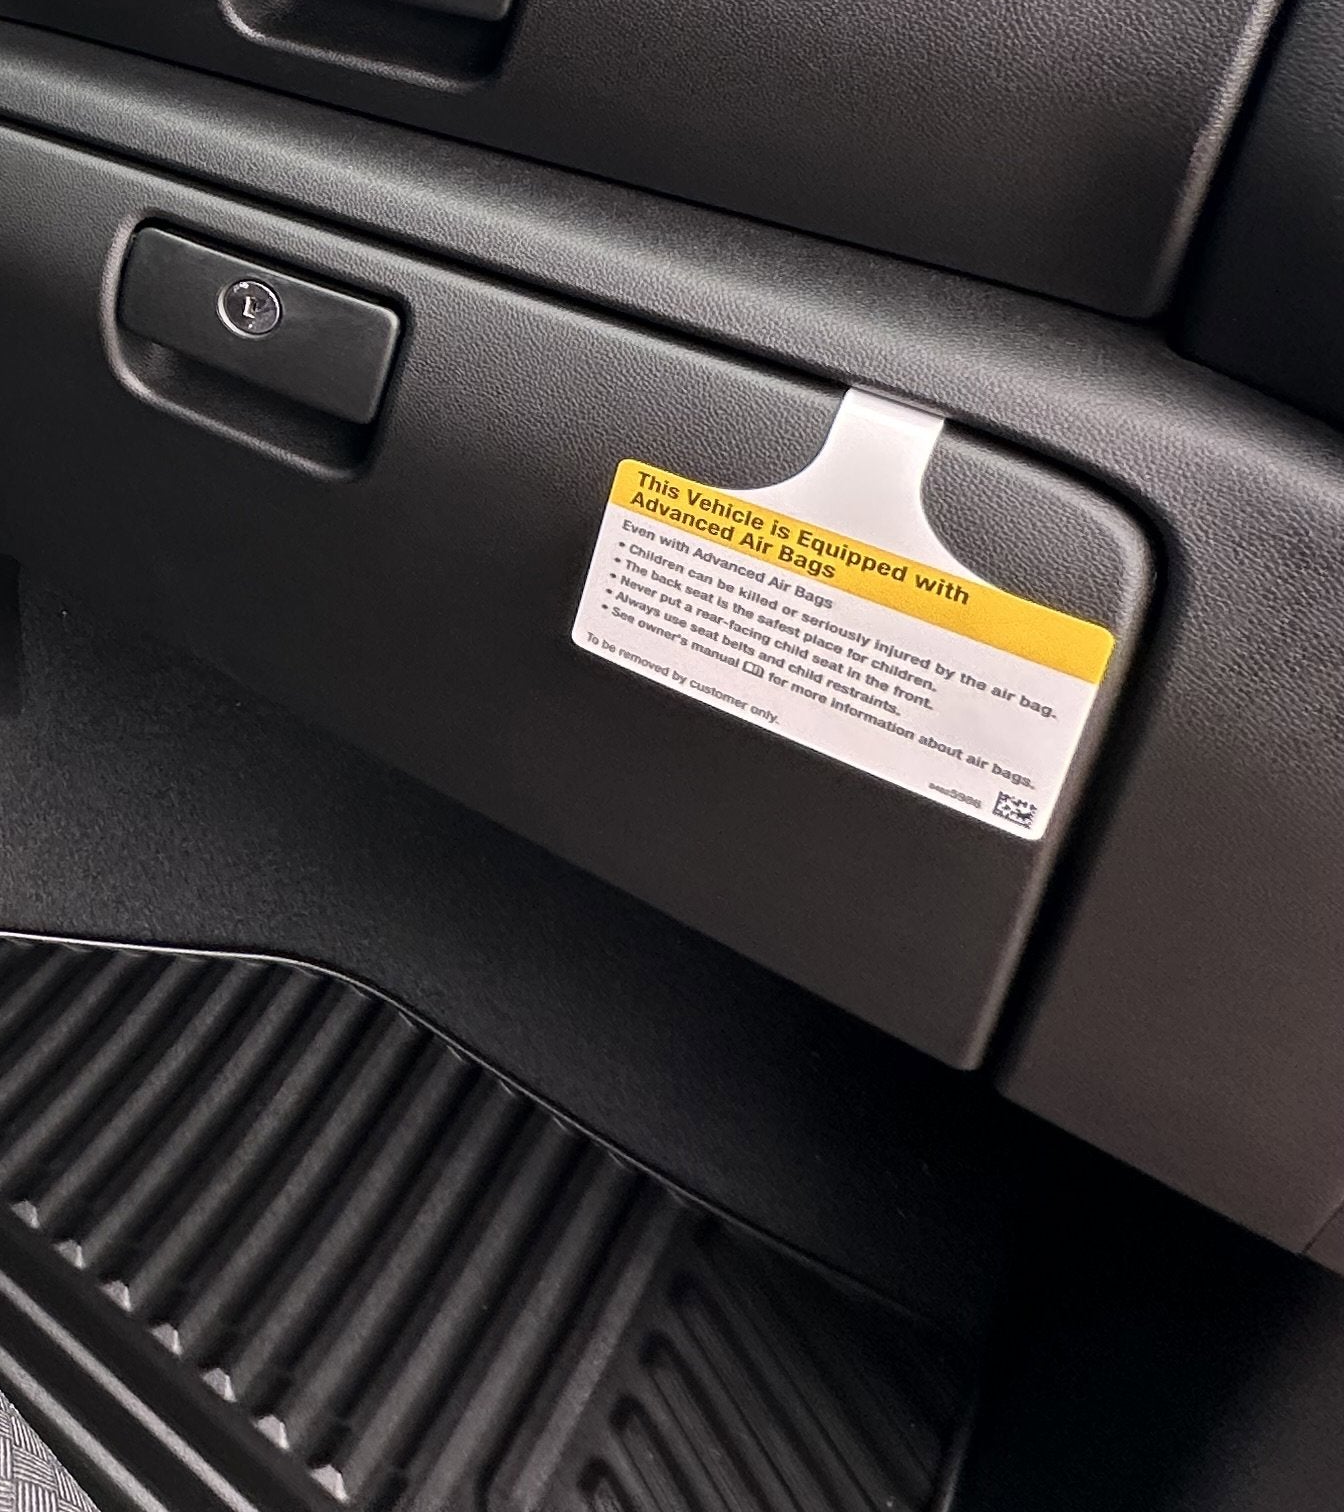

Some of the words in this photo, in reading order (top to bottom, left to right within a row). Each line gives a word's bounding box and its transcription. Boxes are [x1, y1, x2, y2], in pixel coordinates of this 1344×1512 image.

[620, 518, 657, 542] Even
[658, 534, 691, 555] with
[691, 546, 767, 585] Advanced
[766, 575, 793, 593] Air
[793, 584, 834, 610] Bags
[628, 489, 737, 546] Advanced
[737, 531, 775, 556] Air
[776, 543, 837, 580] Bags
[636, 470, 681, 501] This
[686, 487, 766, 532] Vehicle
[769, 518, 793, 541] is
[795, 528, 910, 584] Equipped
[914, 573, 971, 607] with
[586, 630, 601, 646] To
[600, 638, 617, 654] be
[617, 647, 671, 678] removed
[671, 669, 689, 686] by
[688, 679, 750, 711] customer
[749, 704, 780, 726] only.
[614, 590, 662, 618] Always
[662, 611, 688, 629] use
[688, 622, 721, 643] seat
[720, 633, 756, 657] belts
[757, 650, 787, 670] and
[787, 663, 825, 685] child
[825, 678, 902, 718] restraints.
[619, 574, 659, 599] Never
[658, 592, 683, 610] put
[682, 602, 694, 614] a
[694, 607, 773, 647] rear-facing
[773, 639, 811, 661] child
[810, 654, 845, 675] seat
[845, 665, 862, 682] in
[864, 673, 891, 693] the
[892, 684, 935, 711] front.
[625, 558, 649, 578] The
[650, 569, 683, 592] back
[683, 585, 715, 605] seat
[715, 595, 730, 611] is
[731, 601, 756, 620] the
[756, 614, 802, 639] safest
[801, 631, 844, 656] place
[845, 647, 870, 665] for
[869, 658, 938, 694] children.
[628, 543, 686, 575] Children
[686, 568, 714, 586] can
[716, 577, 736, 594] be
[737, 585, 779, 612] killed
[780, 605, 800, 618] or
[800, 612, 872, 648] seriously
[872, 638, 932, 671] injured
[933, 661, 957, 681] by
[958, 672, 988, 692] the
[989, 686, 1018, 702] air
[1018, 694, 1058, 720] bag.
[610, 605, 636, 625] See
[636, 619, 689, 647] owner's
[690, 640, 741, 669] manual
[767, 671, 790, 688] for
[789, 682, 829, 705] more
[829, 696, 916, 741] information
[917, 734, 965, 762] about
[964, 754, 991, 770] air
[990, 762, 1036, 791] bags.
